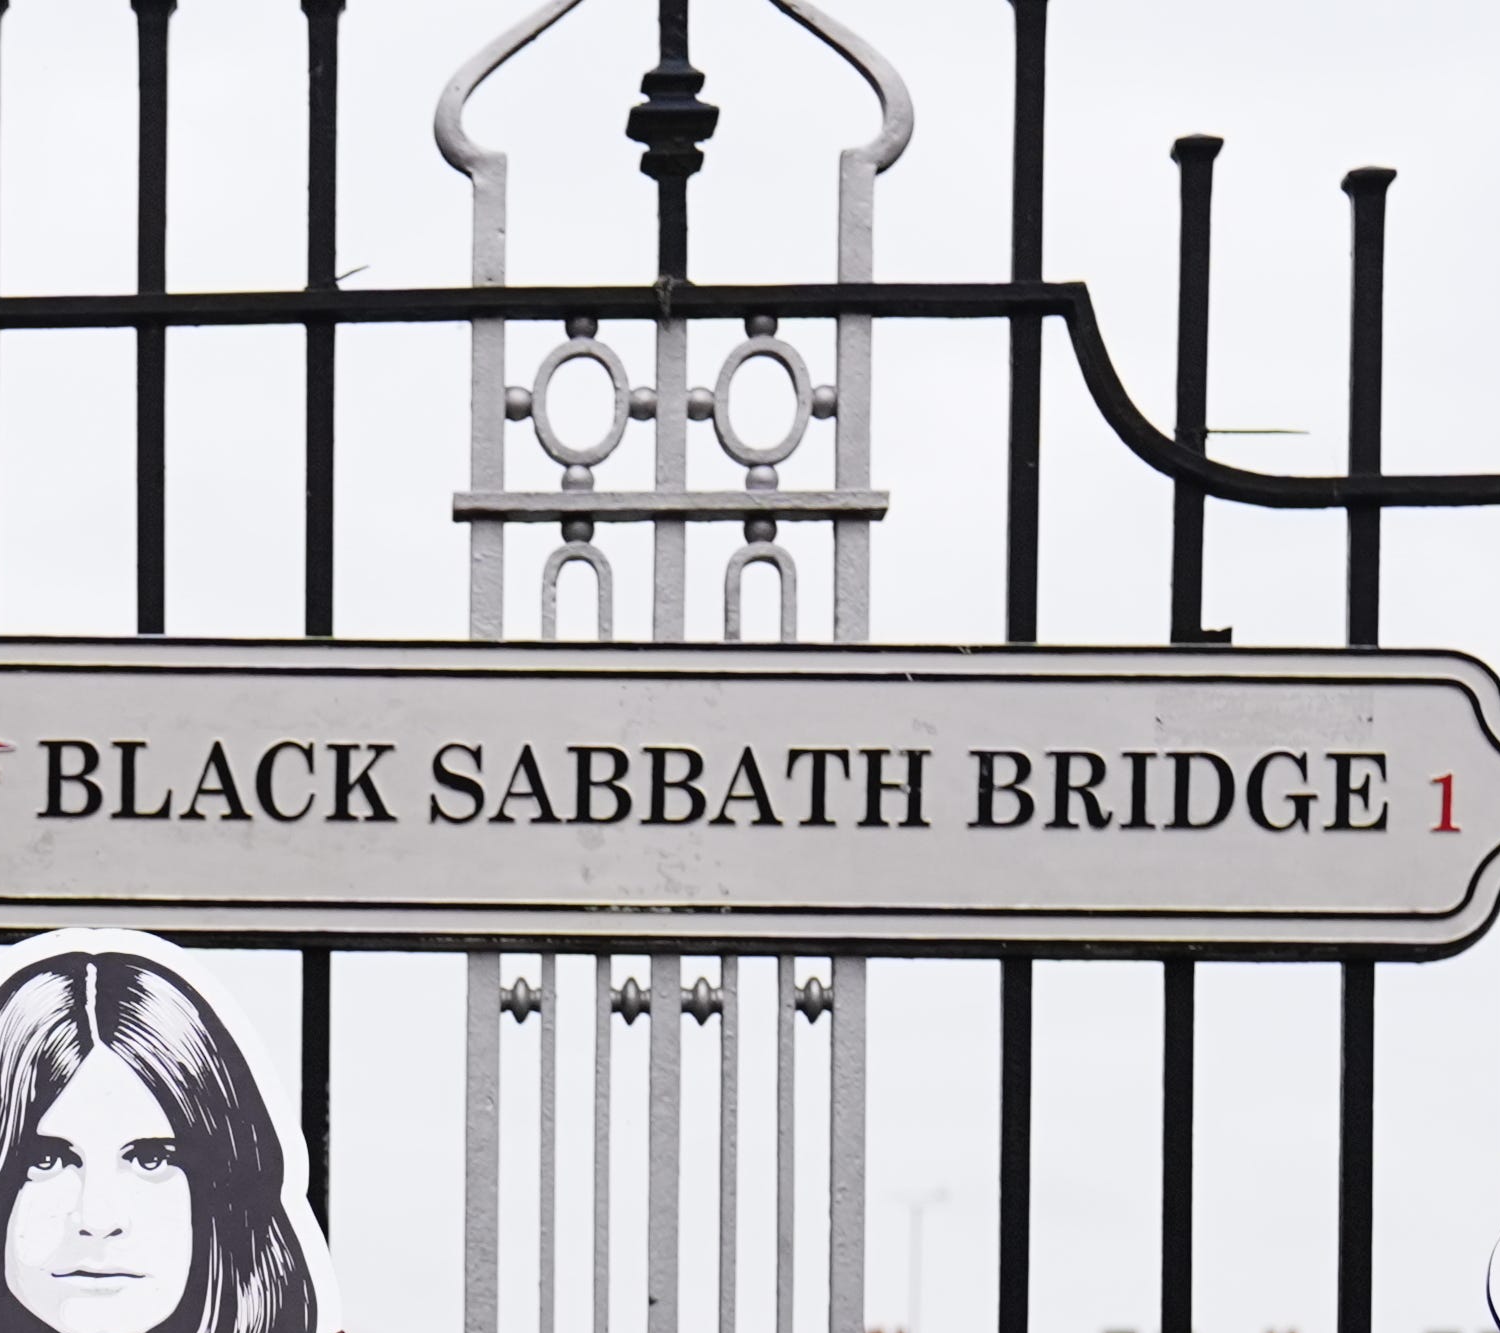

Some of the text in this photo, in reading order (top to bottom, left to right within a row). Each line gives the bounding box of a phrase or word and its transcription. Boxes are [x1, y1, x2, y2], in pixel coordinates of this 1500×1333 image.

[37, 738, 1459, 835] BLACK SABBATH BRIDGE 1
